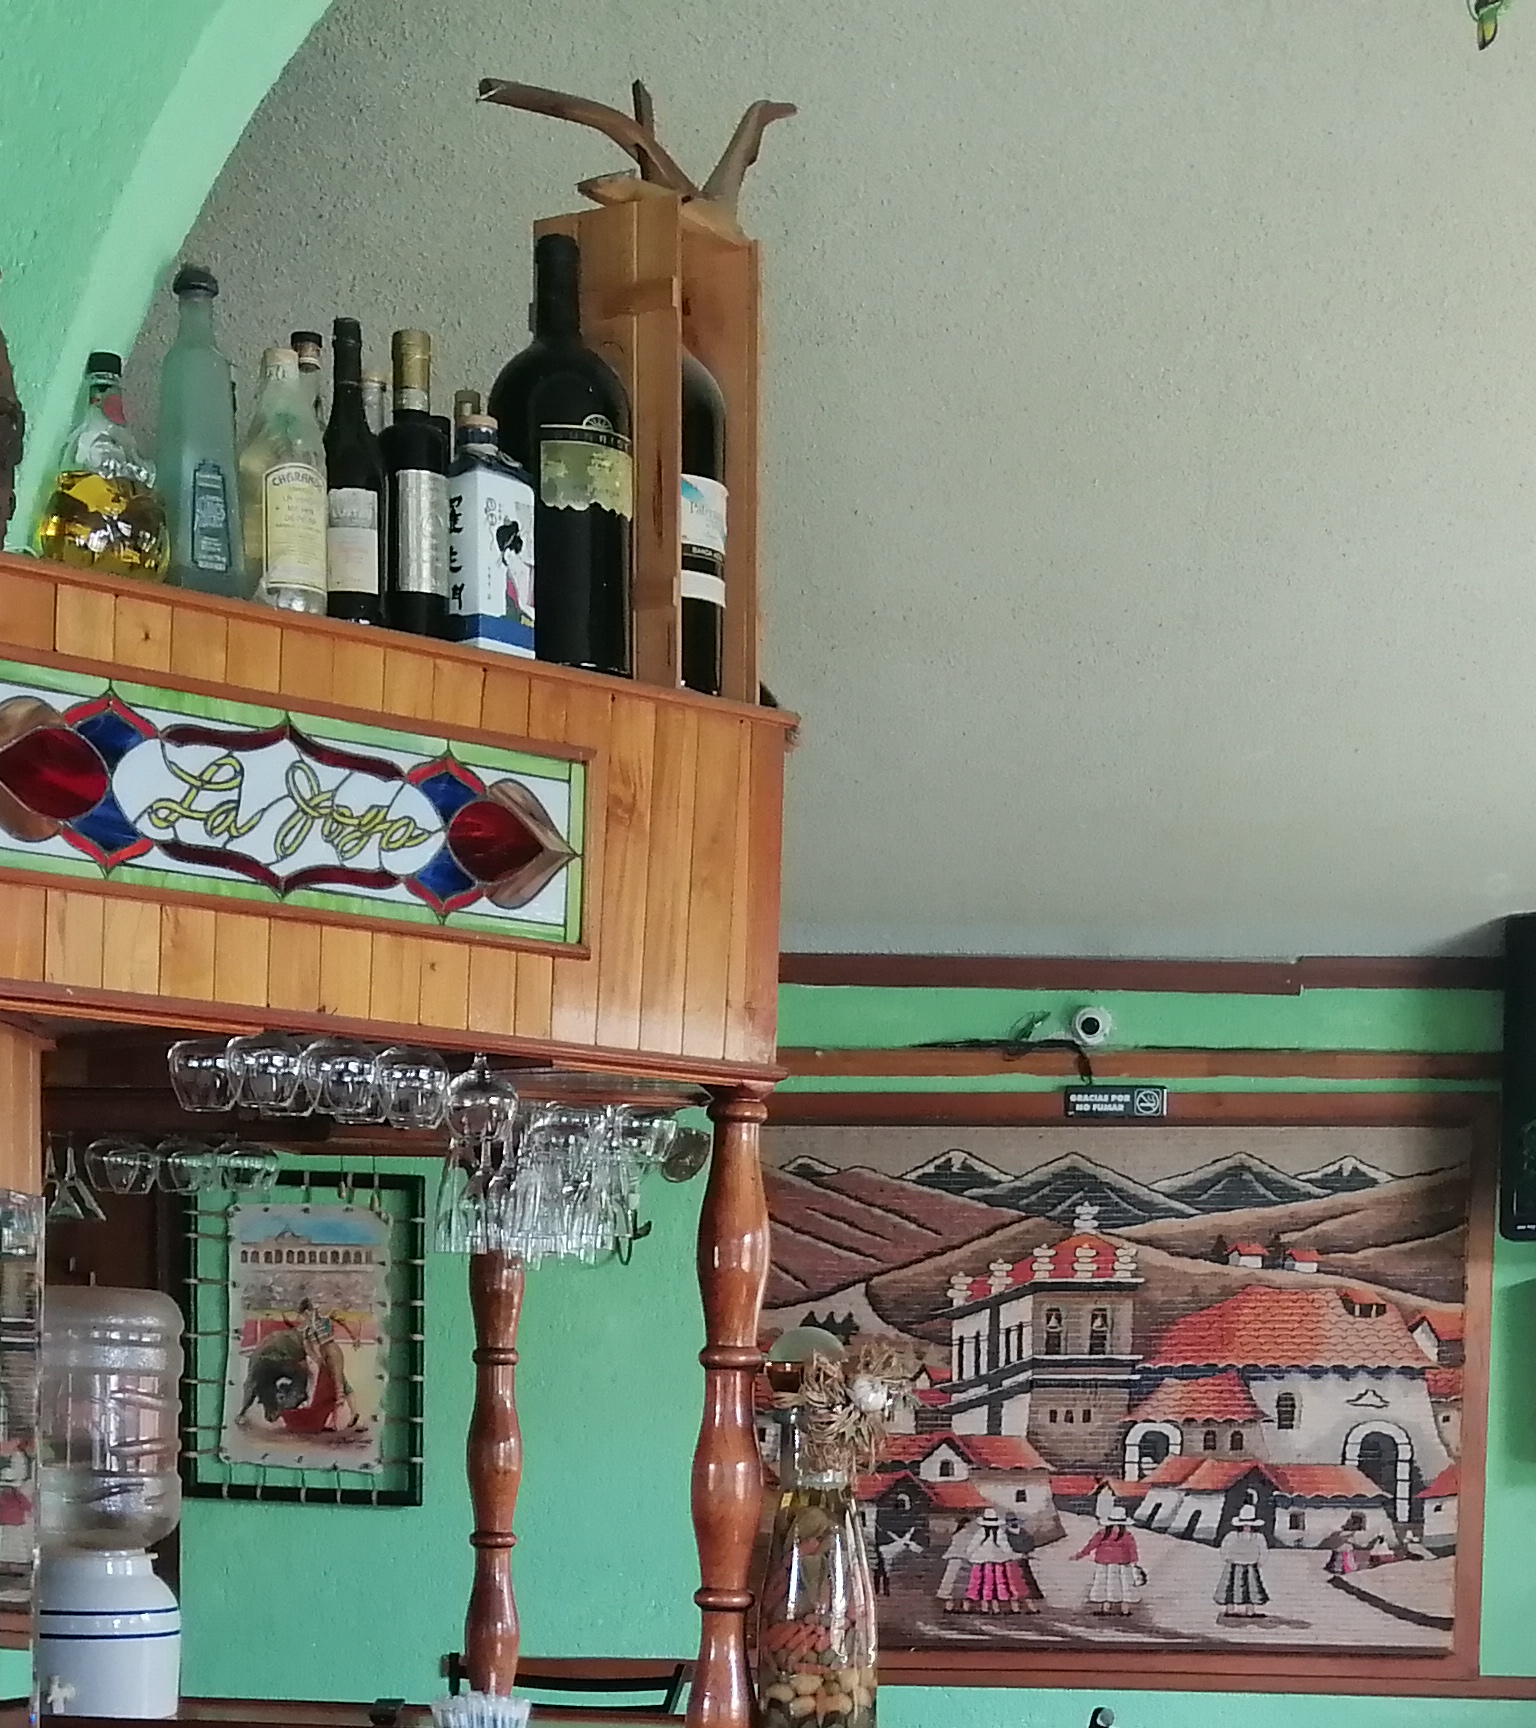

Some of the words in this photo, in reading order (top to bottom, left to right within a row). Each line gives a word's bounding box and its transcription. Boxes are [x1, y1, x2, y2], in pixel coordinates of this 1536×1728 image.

[148, 753, 264, 838] La
[1069, 1093, 1109, 1102] GRACIAS
[1111, 1093, 1131, 1102] POR
[1075, 1103, 1091, 1111] NO
[1092, 1103, 1125, 1111] FUMAR
